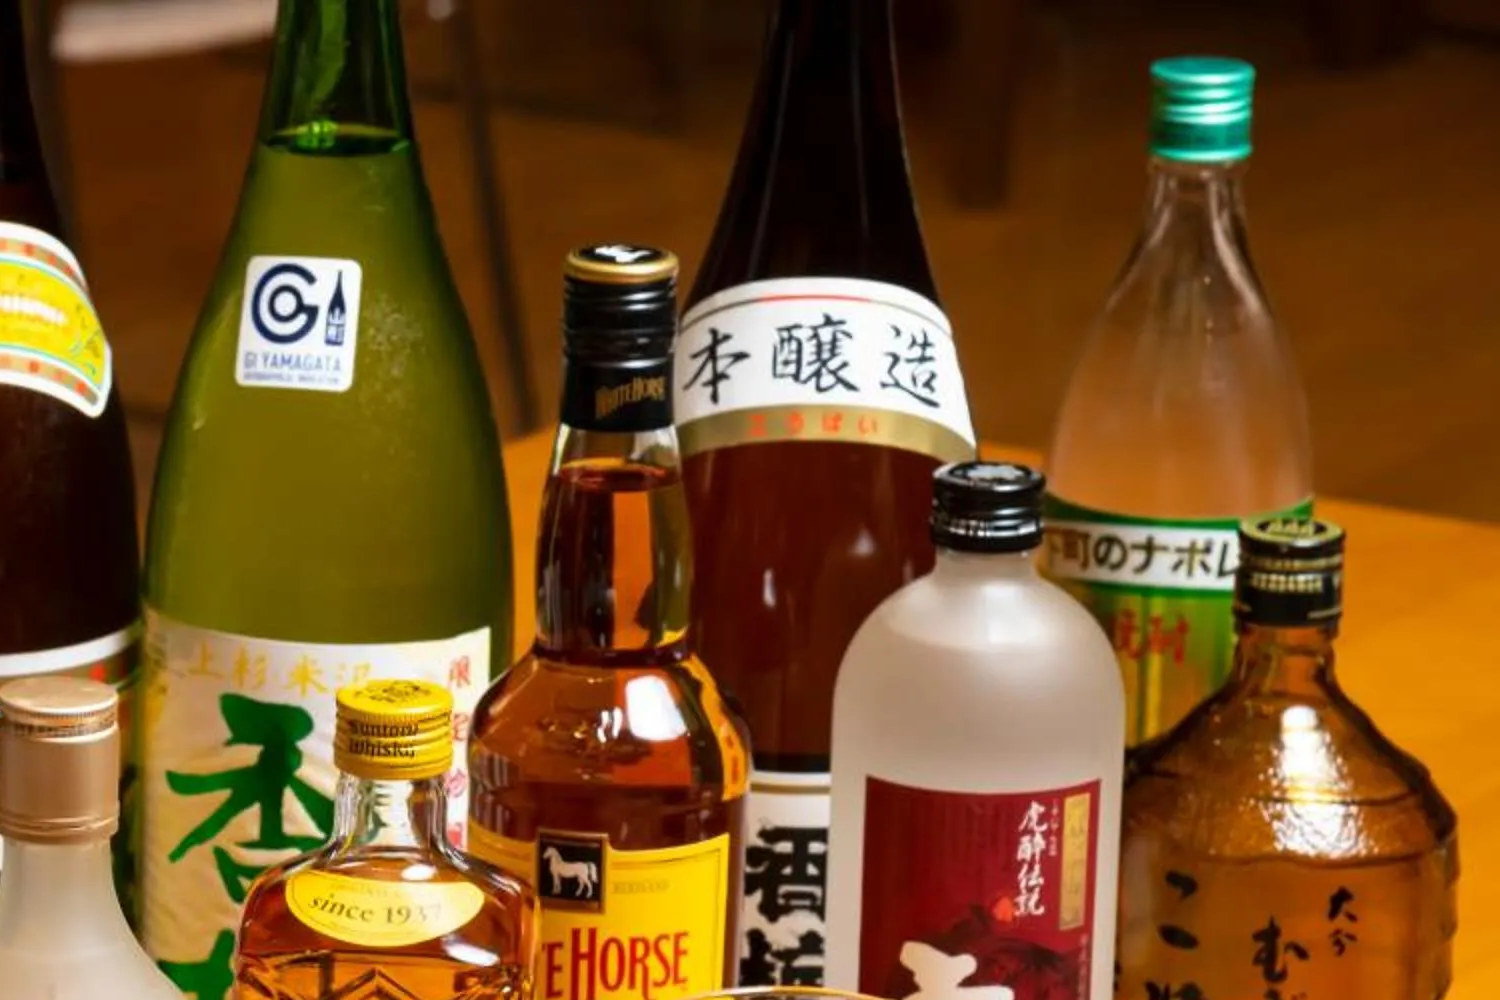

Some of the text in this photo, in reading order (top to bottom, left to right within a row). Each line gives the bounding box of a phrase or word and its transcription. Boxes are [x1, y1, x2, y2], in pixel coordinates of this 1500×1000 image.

[262, 352, 341, 372] YAMAGATA
[682, 313, 941, 408] 本醸造
[347, 720, 419, 738] Suntory
[349, 737, 415, 758] Whisky
[309, 892, 443, 925] since 1937
